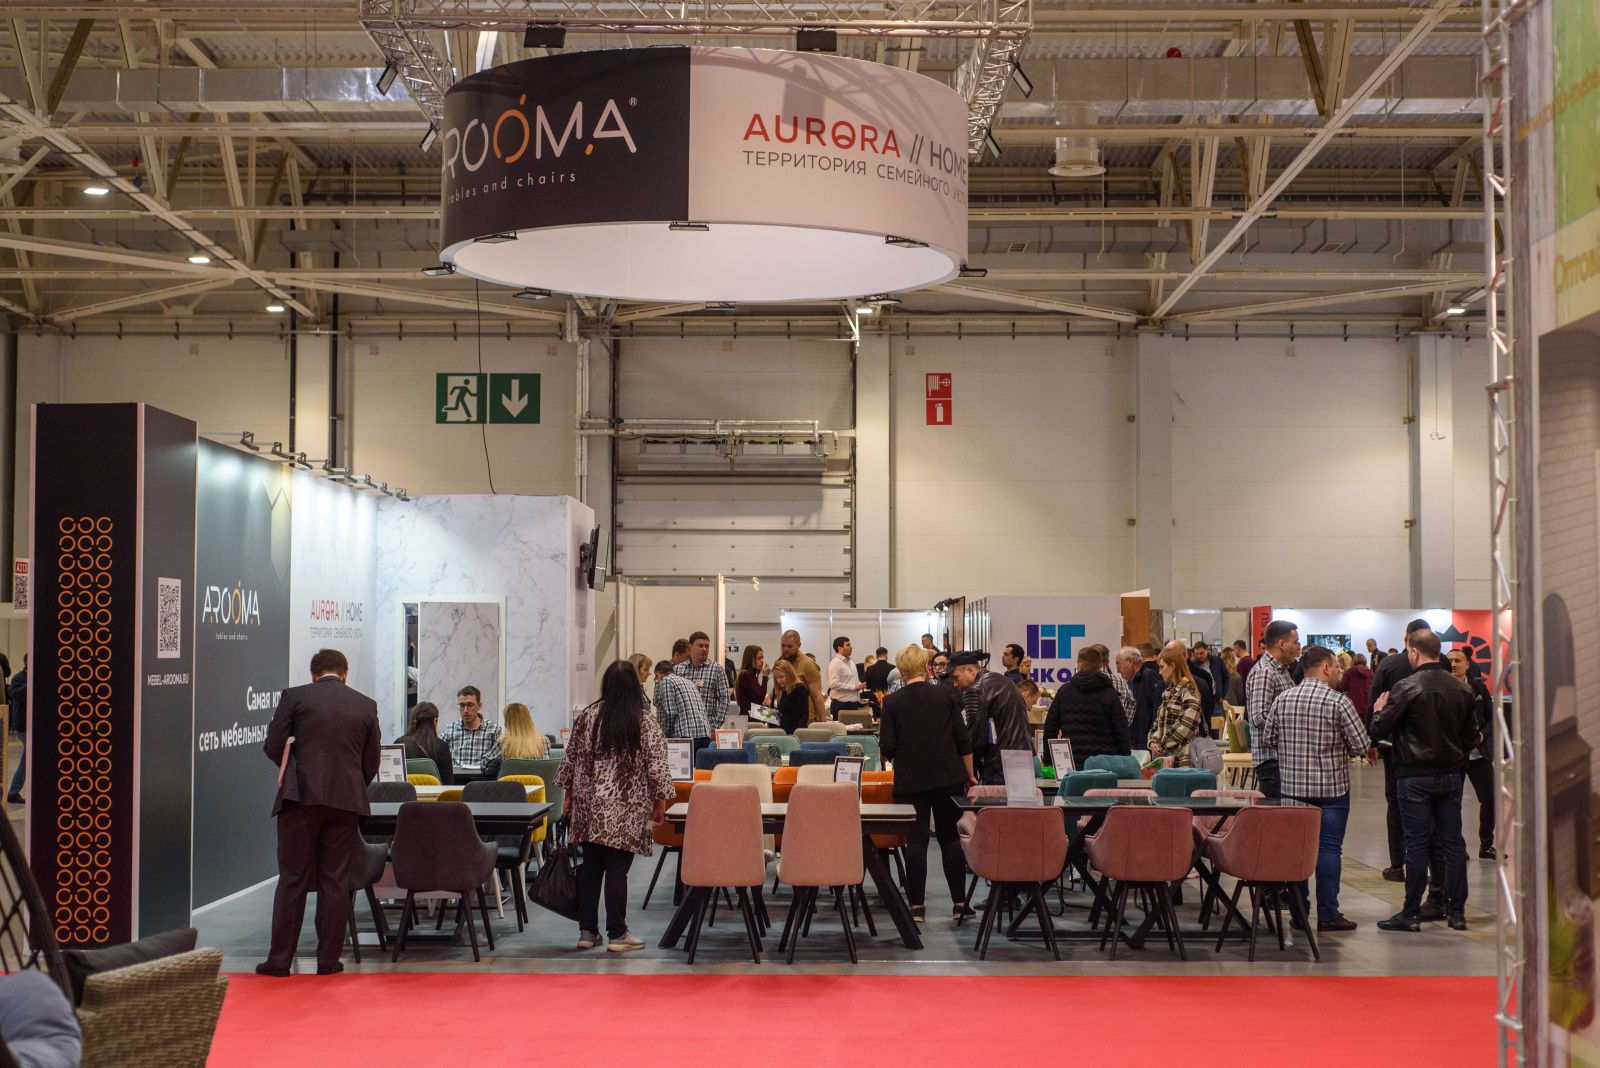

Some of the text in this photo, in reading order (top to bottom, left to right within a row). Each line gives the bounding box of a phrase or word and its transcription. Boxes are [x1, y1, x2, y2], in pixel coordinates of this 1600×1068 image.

[743, 113, 900, 158] AURORA
[930, 140, 967, 185] HOME
[483, 176, 507, 193] and
[517, 171, 576, 187] chairs
[742, 150, 867, 176] ТЕРРИТОРИЯ
[876, 164, 950, 196] СЕМЕЙНОГО
[310, 599, 340, 621] AURORA
[346, 601, 363, 622] HOME
[246, 685, 271, 711] Самая
[199, 721, 268, 752] сеть мебельных
